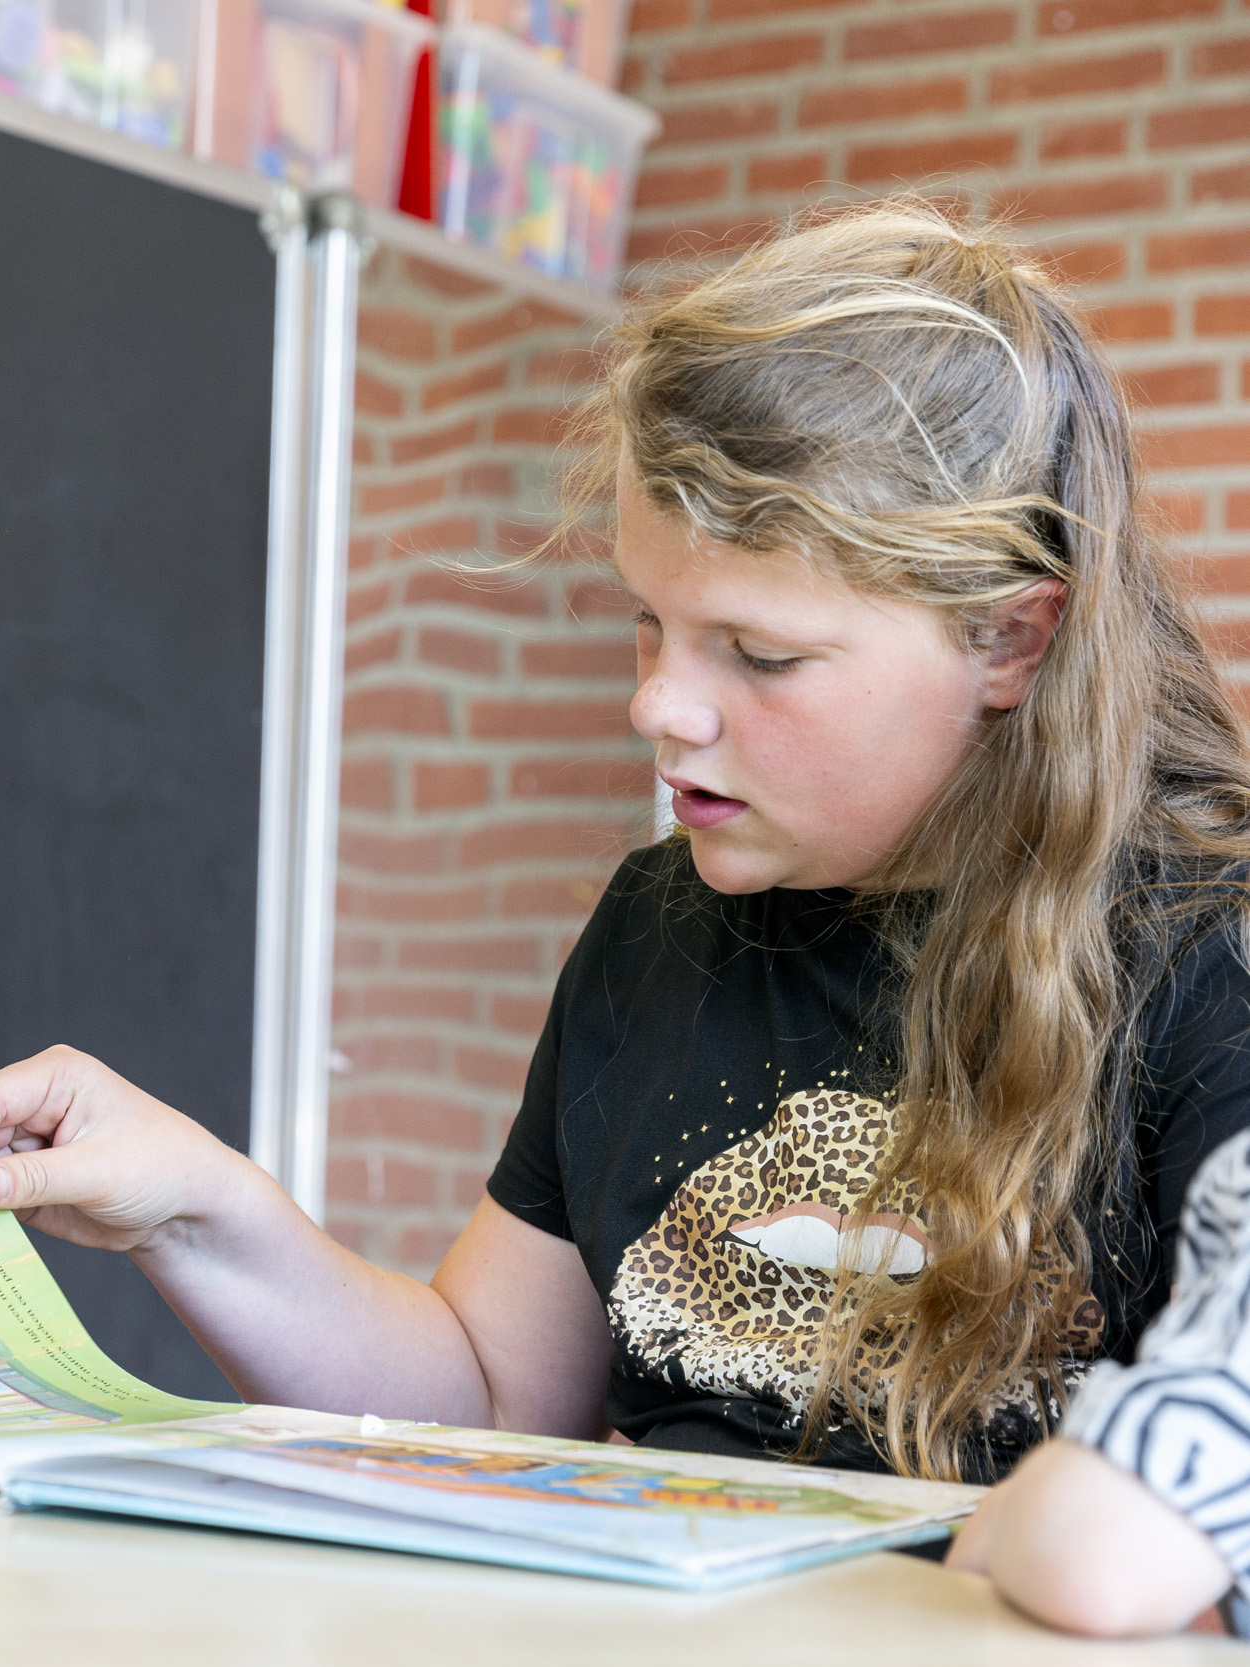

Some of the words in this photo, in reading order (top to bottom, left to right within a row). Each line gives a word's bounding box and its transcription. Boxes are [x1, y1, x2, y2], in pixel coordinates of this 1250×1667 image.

[10, 1285, 27, 1306] een
[7, 1304, 25, 1324] een
[27, 1309, 54, 1344] steken
[58, 1346, 91, 1375] matras
